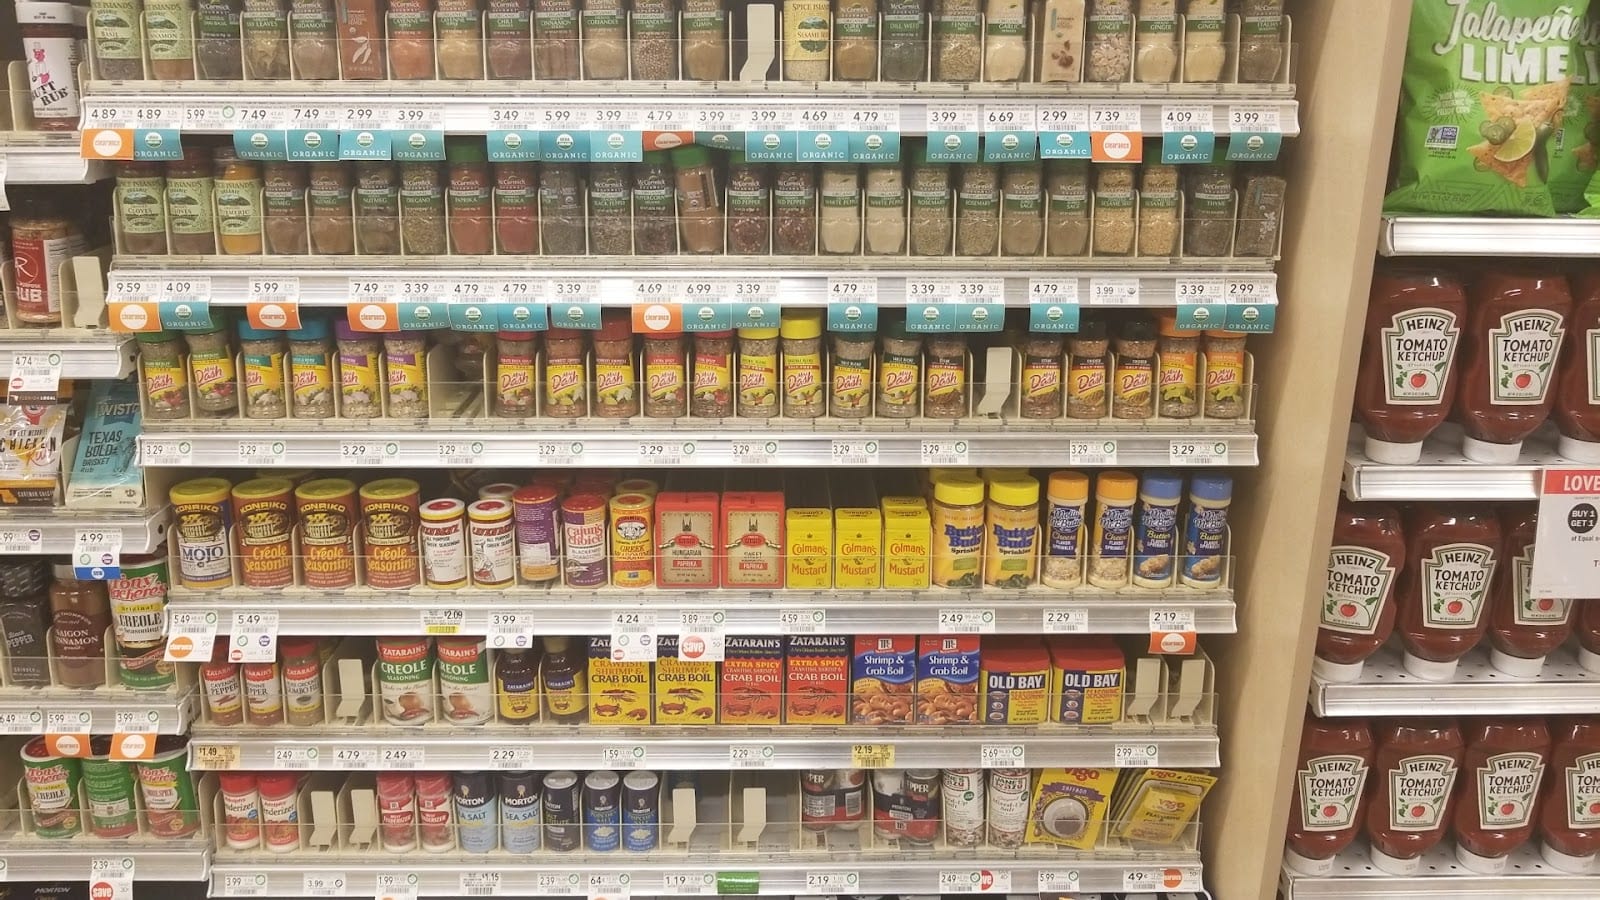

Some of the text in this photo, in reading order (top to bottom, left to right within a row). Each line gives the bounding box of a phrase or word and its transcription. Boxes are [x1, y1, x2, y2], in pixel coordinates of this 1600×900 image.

[1460, 43, 1569, 84] LIME
[33, 81, 56, 99] UTT
[1406, 318, 1446, 331] HEINZ
[1514, 319, 1552, 332] HEINZ
[1395, 338, 1448, 351] TOMATO
[1503, 339, 1553, 352] TOMATO
[1397, 351, 1445, 362] KETCHUP
[1503, 351, 1550, 362] KETCHUP
[88, 430, 123, 443] TEXAS
[240, 502, 287, 514] KONRIKO
[300, 502, 346, 513] KONRIKO
[183, 545, 224, 563] MOJO
[792, 543, 828, 556] Colman's
[841, 543, 877, 556] Colman's
[890, 543, 926, 556] Colman's
[1336, 555, 1377, 568] HEINZ
[1444, 553, 1482, 564] HEINZ
[791, 563, 827, 576] Mustard
[841, 563, 876, 576] Mustard
[889, 563, 925, 576] Mustard
[1434, 569, 1484, 581] TOMATO
[1327, 569, 1380, 587] TOMATO
[1328, 583, 1377, 596] KETCHUP
[1435, 581, 1481, 591] KETCHUP
[119, 614, 162, 628] CREOLE
[683, 642, 704, 653] save
[864, 655, 904, 665] Shrimp &
[929, 655, 969, 665] Shrimp &
[381, 662, 427, 675] CREOLE
[866, 666, 904, 675] Crab Boil
[930, 666, 968, 675] Crab Boil
[591, 674, 648, 683] CRAB BOIL
[658, 673, 714, 682] CRAB BOIL
[724, 674, 781, 682] CRAB BOIL
[789, 673, 845, 681] CRAB BOIL
[989, 675, 1043, 689] OLD BAY
[1064, 673, 1119, 687] OLD BAY
[1318, 762, 1353, 773] HEINZ
[1409, 762, 1443, 773] HEINZ
[1498, 759, 1532, 770] HEINZ
[1310, 777, 1356, 789] TOMATO
[1400, 777, 1446, 788] TOMATO
[1489, 774, 1534, 786] TOMATO
[1311, 787, 1354, 798] KETCHUP
[1400, 787, 1442, 797] KETCHUP
[1490, 783, 1531, 795] KETCHUP
[505, 795, 538, 806] MORTON
